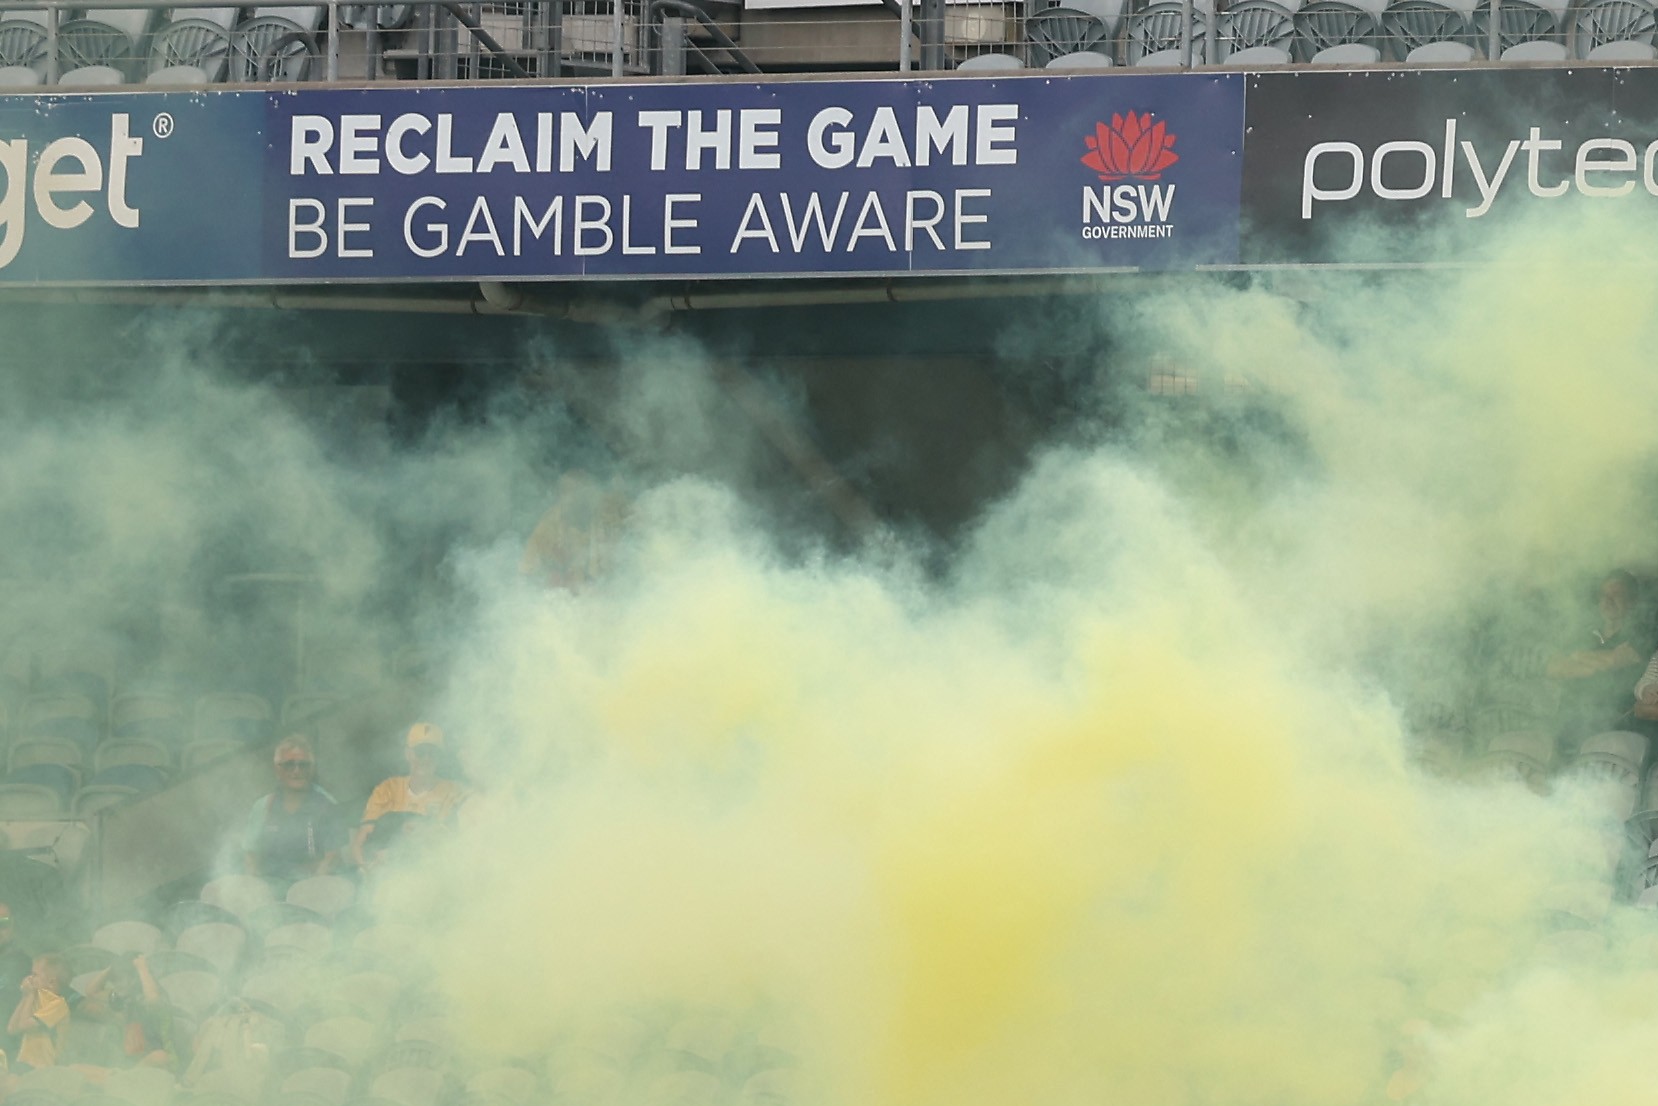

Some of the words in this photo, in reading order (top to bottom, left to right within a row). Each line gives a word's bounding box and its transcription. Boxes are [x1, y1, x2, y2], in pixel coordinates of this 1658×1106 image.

[291, 111, 612, 175] RECLAIM
[639, 108, 782, 172] THE
[807, 104, 1020, 170] GAME
[288, 197, 375, 259] BE
[403, 192, 702, 258] GAMBLE
[730, 187, 992, 255] AWARE
[1082, 184, 1176, 223] NSW
[1082, 225, 1174, 239] GOVERNMENT
